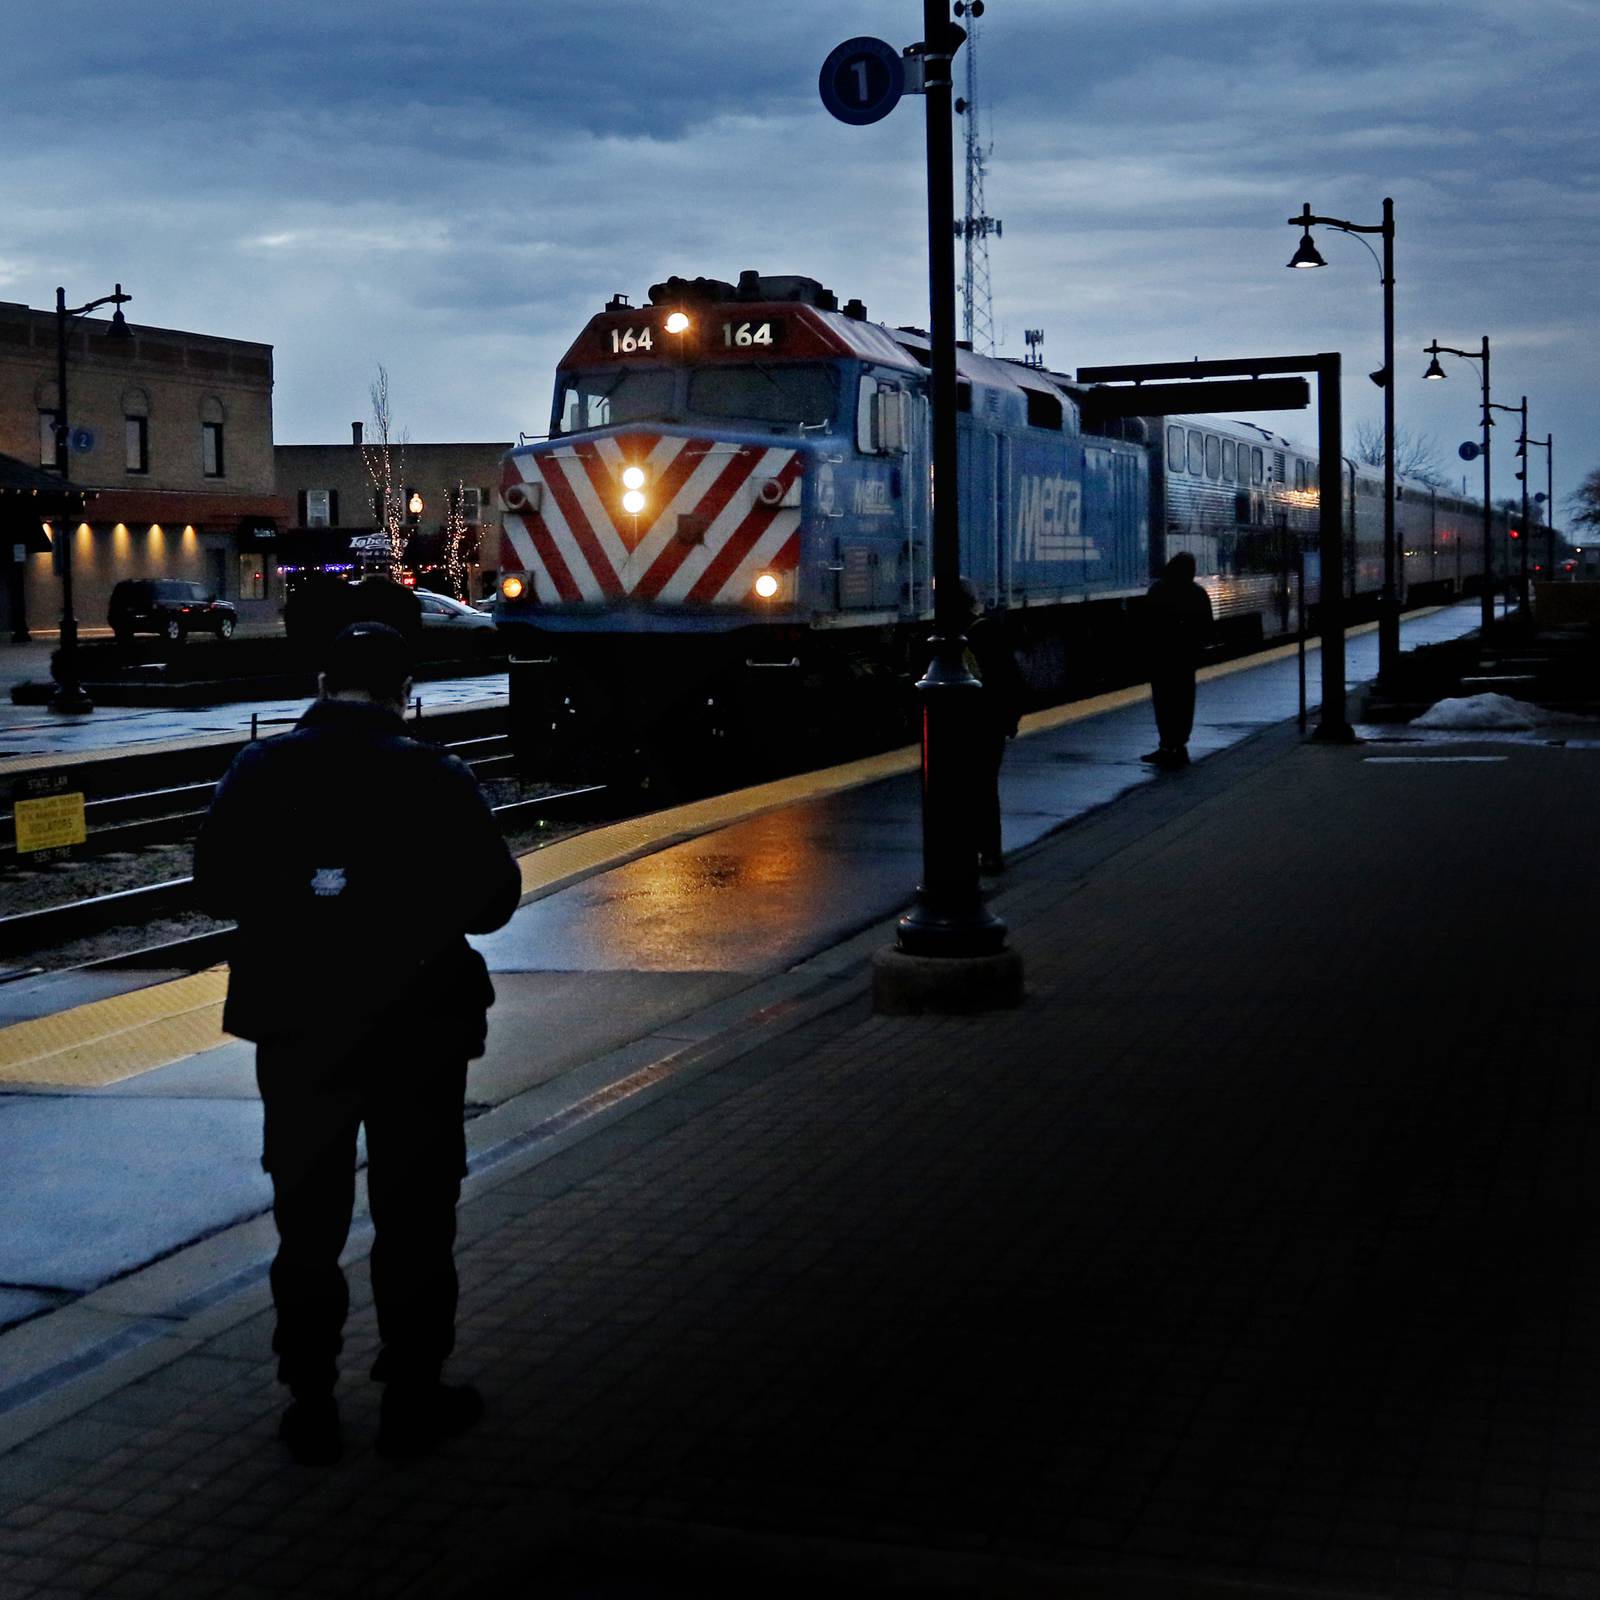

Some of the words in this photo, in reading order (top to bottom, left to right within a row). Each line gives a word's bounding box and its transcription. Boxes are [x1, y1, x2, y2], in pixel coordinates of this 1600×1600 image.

[850, 58, 869, 101] 1
[611, 325, 653, 354] 164
[722, 322, 774, 347] 164
[80, 434, 87, 447] 2
[1014, 474, 1100, 561] Metra
